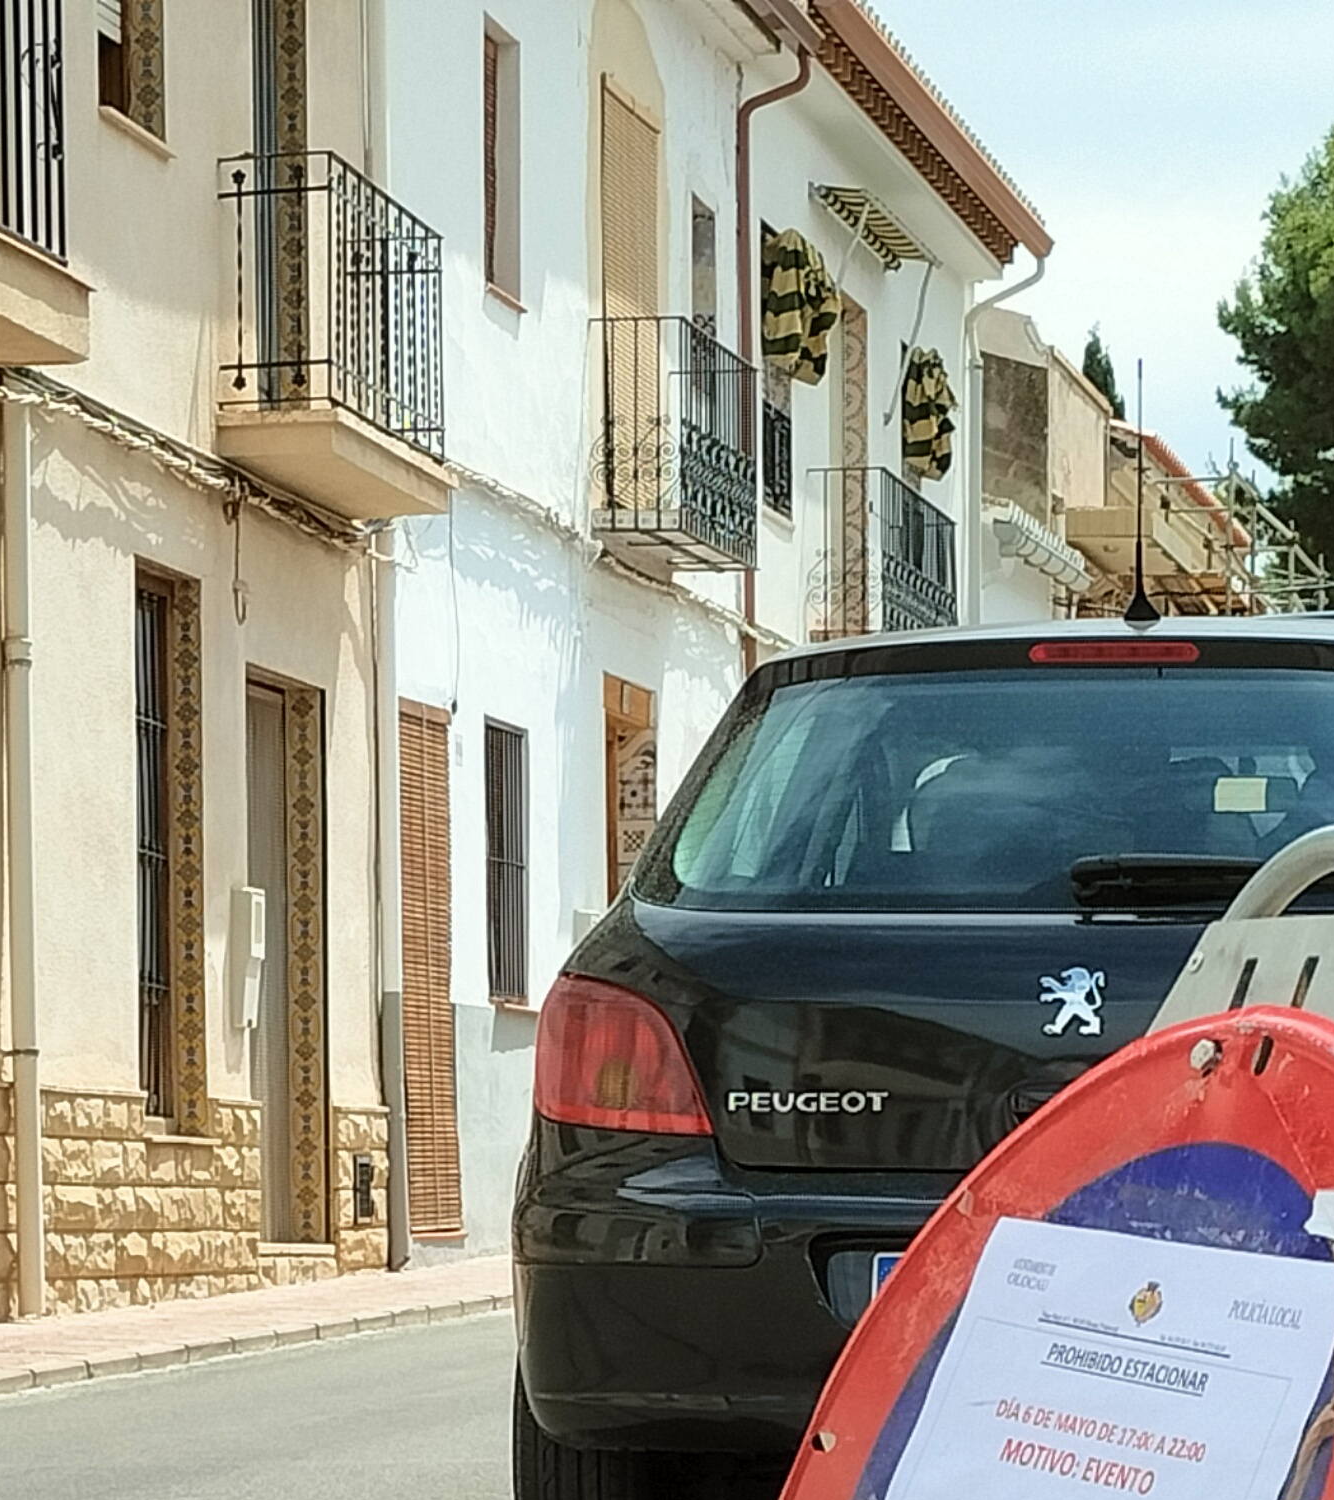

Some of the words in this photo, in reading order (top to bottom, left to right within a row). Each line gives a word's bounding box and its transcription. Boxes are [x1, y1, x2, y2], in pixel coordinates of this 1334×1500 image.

[727, 1091, 889, 1113] PEUGEOT
[1046, 1342, 1123, 1375] PROHIBIDO
[1123, 1358, 1209, 1393] ESTACIONAR
[995, 1396, 1021, 1421] DÍA
[1021, 1405, 1034, 1424] 6
[1032, 1408, 1055, 1428] DE
[1054, 1413, 1098, 1438] MAYO
[1096, 1422, 1119, 1443] DE
[1153, 1435, 1167, 1455] A
[1166, 1437, 1207, 1463] 22:00
[999, 1438, 1080, 1479] MOTIVO:
[1081, 1456, 1156, 1495] EVENTO
